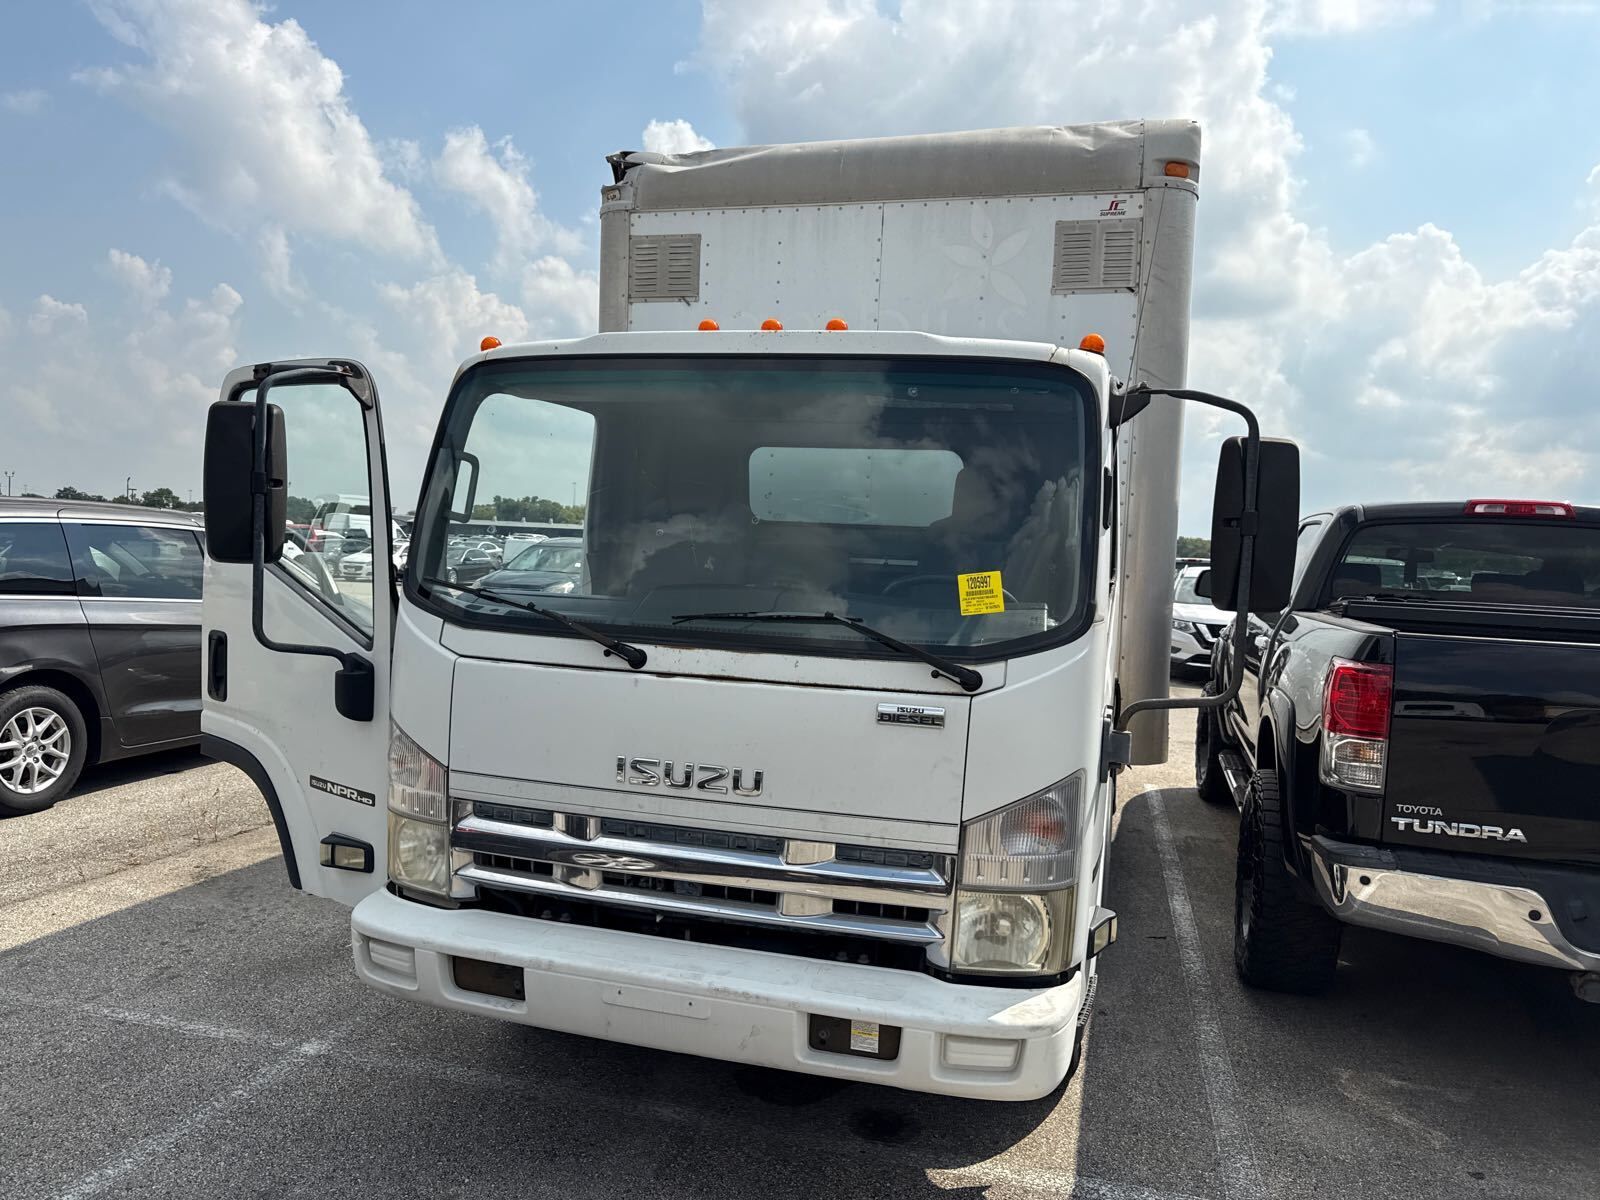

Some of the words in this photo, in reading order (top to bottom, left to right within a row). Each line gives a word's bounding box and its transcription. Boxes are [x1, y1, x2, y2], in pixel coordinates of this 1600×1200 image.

[966, 575, 991, 590] 1205997
[896, 706, 925, 714] ISUZU
[879, 712, 944, 727] DIESEL
[616, 755, 764, 797] ISUZU
[1396, 803, 1443, 817] TOYOTA
[1390, 816, 1529, 843] TUNDRA
